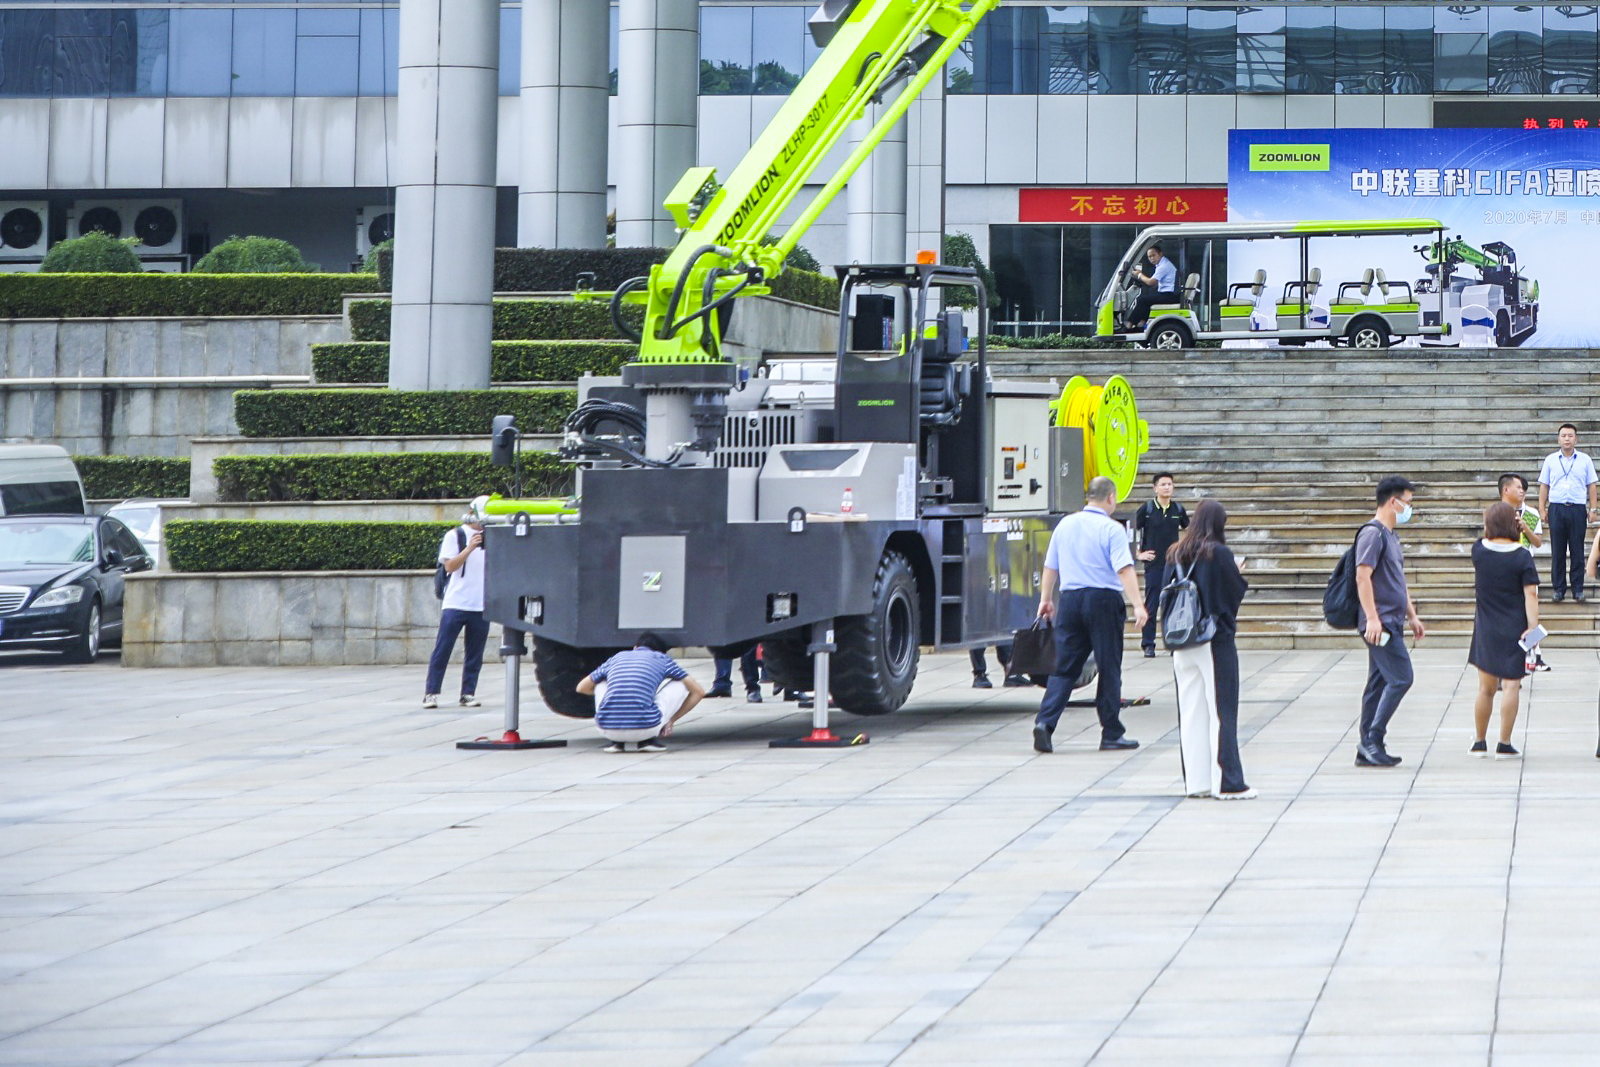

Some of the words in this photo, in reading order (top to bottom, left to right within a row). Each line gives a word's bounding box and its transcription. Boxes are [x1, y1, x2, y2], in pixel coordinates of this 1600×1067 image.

[1258, 153, 1321, 162] ZOOMLION
[715, 164, 782, 247] ZOOMLION
[781, 94, 831, 165] ZLHP-3017
[1070, 194, 1190, 216] 不忘初心
[1483, 209, 1569, 225] 2020年7月
[857, 399, 895, 407] ZOOMLION
[1104, 386, 1122, 405] CIFA
